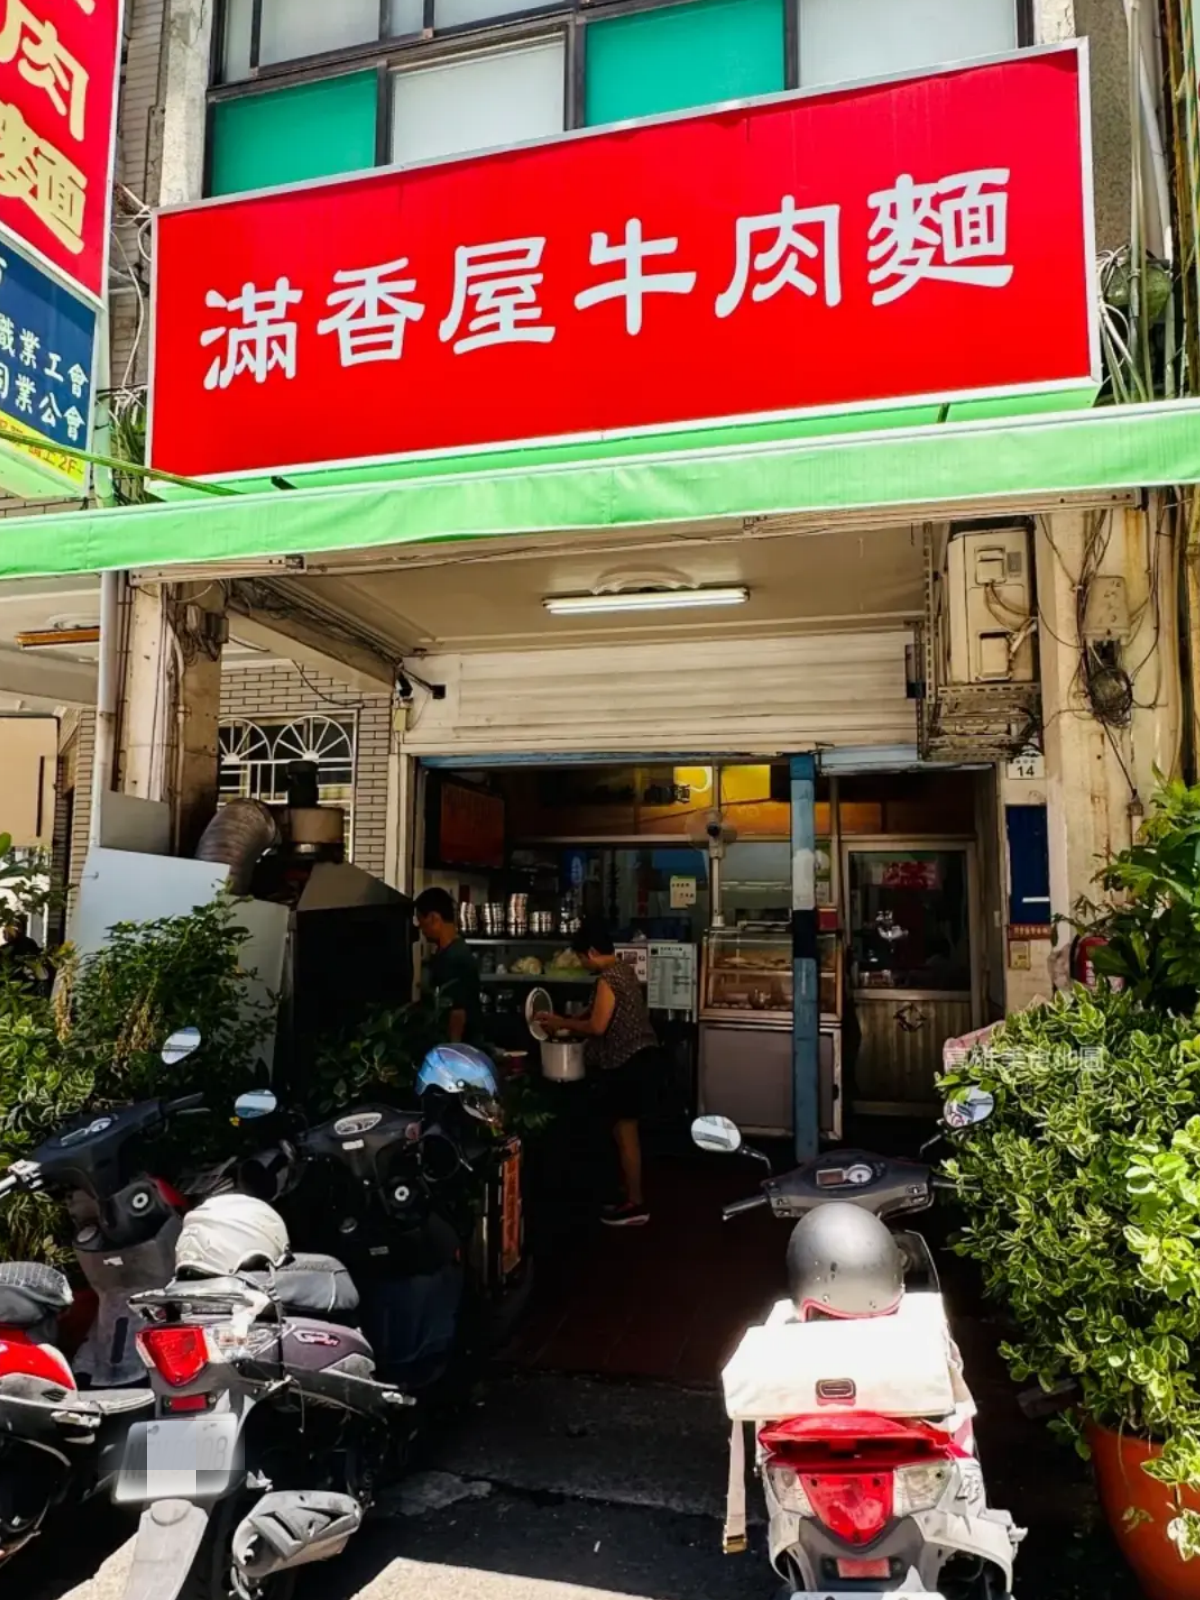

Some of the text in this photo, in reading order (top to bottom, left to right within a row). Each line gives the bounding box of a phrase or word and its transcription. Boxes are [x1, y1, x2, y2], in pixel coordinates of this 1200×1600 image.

[0, 0, 95, 255] 肉麵
[200, 168, 1014, 391] 滿香屋牛肉麵
[1016, 764, 1035, 777] 14
